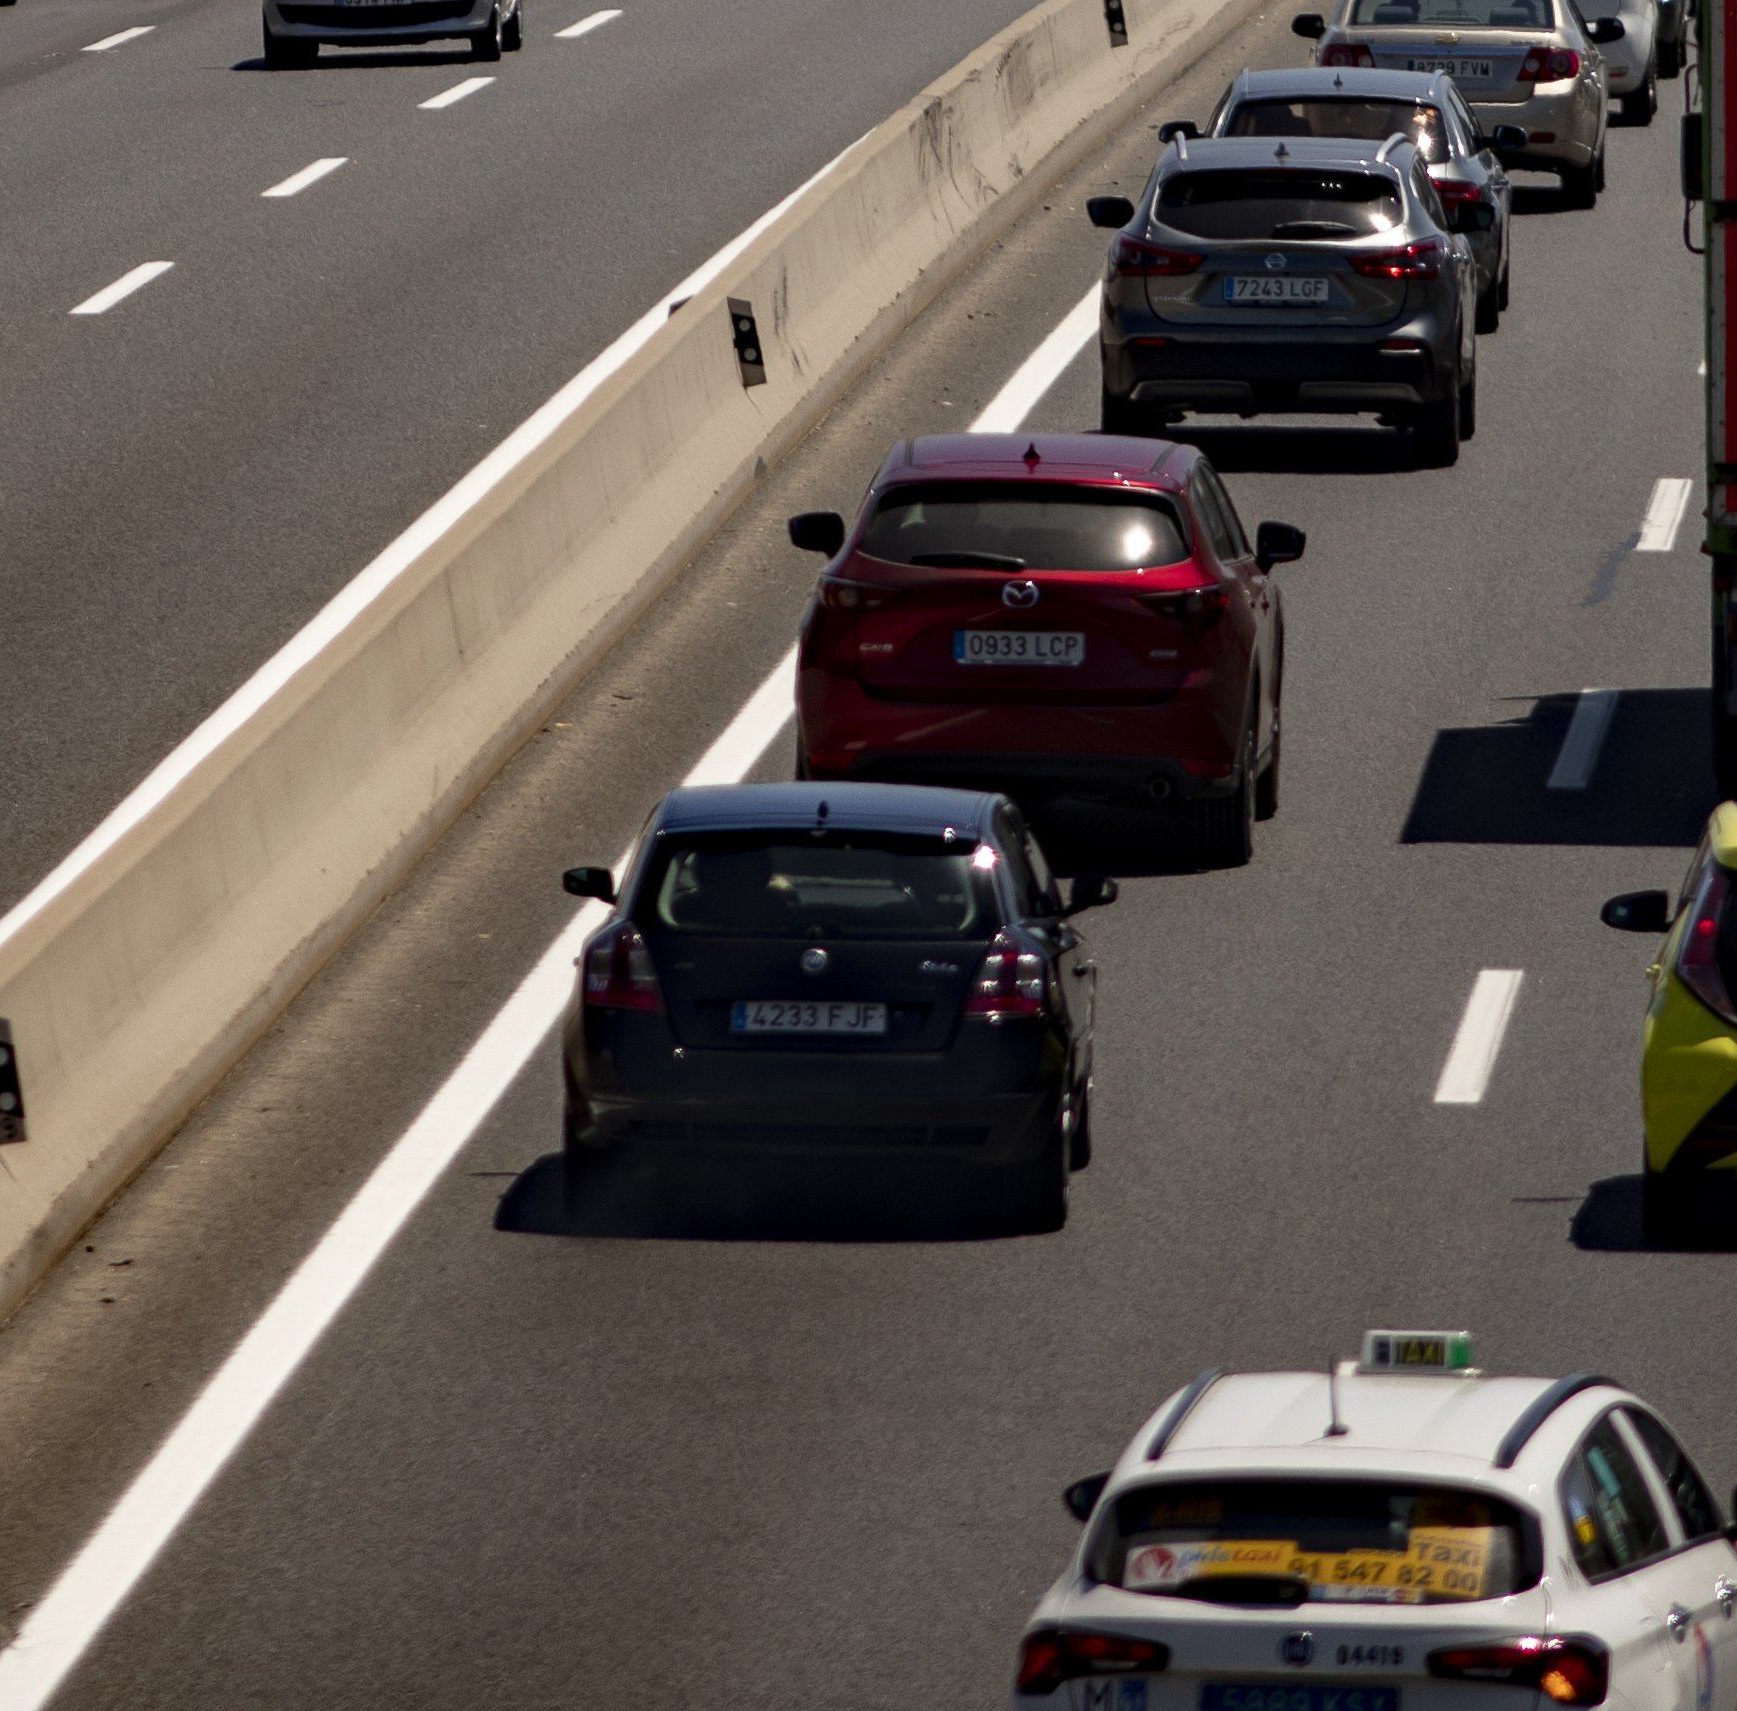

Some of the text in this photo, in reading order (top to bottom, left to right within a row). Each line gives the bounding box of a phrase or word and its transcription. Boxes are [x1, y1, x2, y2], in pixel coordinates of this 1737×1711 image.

[1236, 279, 1326, 298] 7243 LGF
[969, 634, 1079, 657] 0933 LCP
[751, 1003, 818, 1027] 4233
[1333, 1559, 1386, 1582] 547
[1396, 1565, 1434, 1587] 82
[1441, 1568, 1478, 1593] 00
